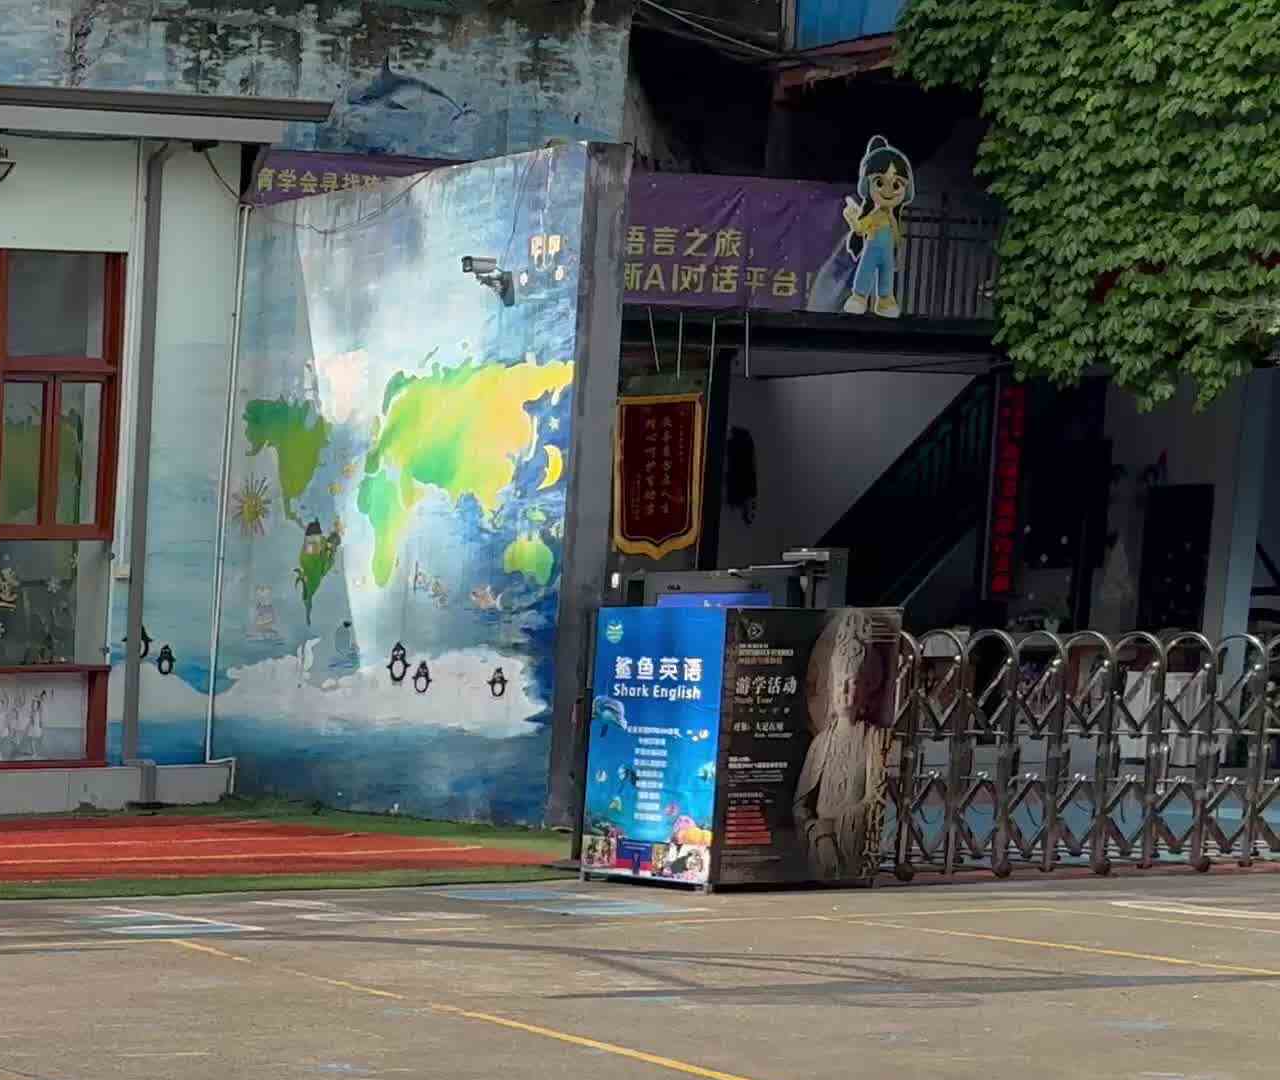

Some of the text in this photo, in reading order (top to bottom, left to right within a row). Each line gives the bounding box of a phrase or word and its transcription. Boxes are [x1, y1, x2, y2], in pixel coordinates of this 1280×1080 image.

[615, 656, 703, 681] 鲨鱼英语
[613, 683, 701, 701] Shark English
